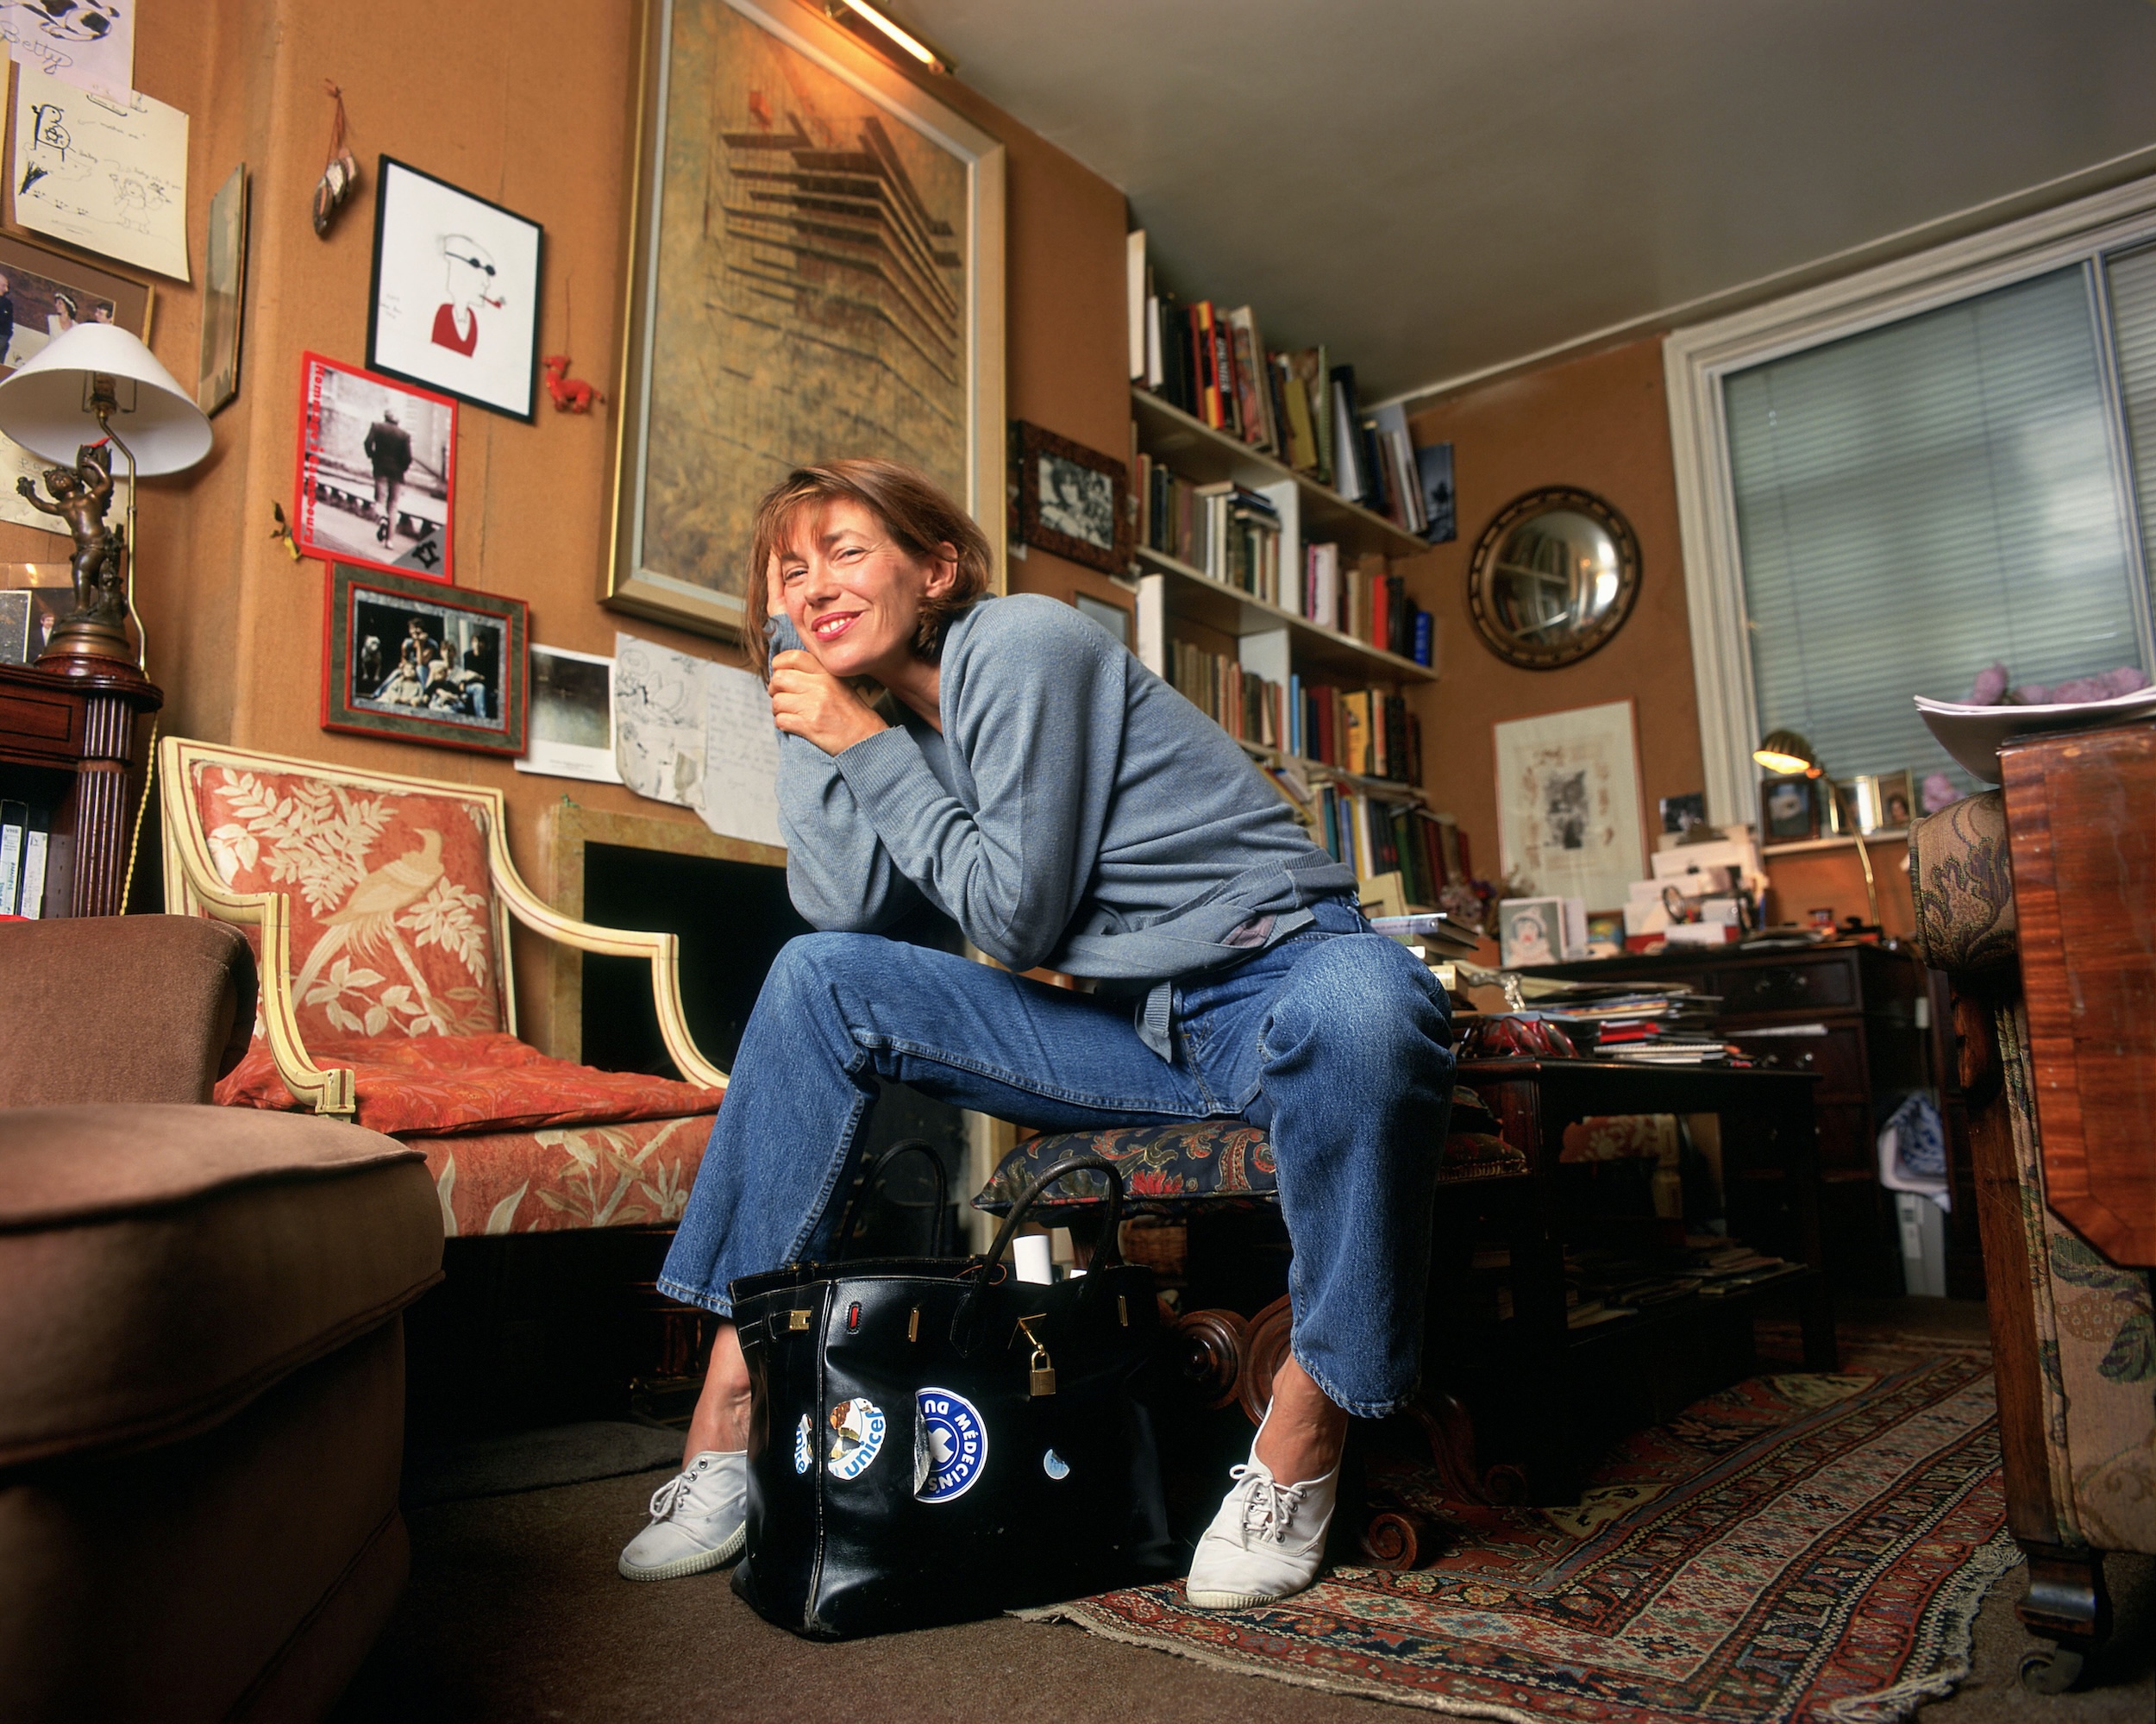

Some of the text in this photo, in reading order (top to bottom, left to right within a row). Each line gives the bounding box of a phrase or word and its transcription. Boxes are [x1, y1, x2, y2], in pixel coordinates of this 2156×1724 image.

[0, 21, 73, 74] Betty
[308, 362, 326, 441] Hommage
[303, 455, 320, 544] Gainsbourg
[844, 1410, 884, 1476] unicef
[924, 1400, 978, 1492] MÉDECINS DU
